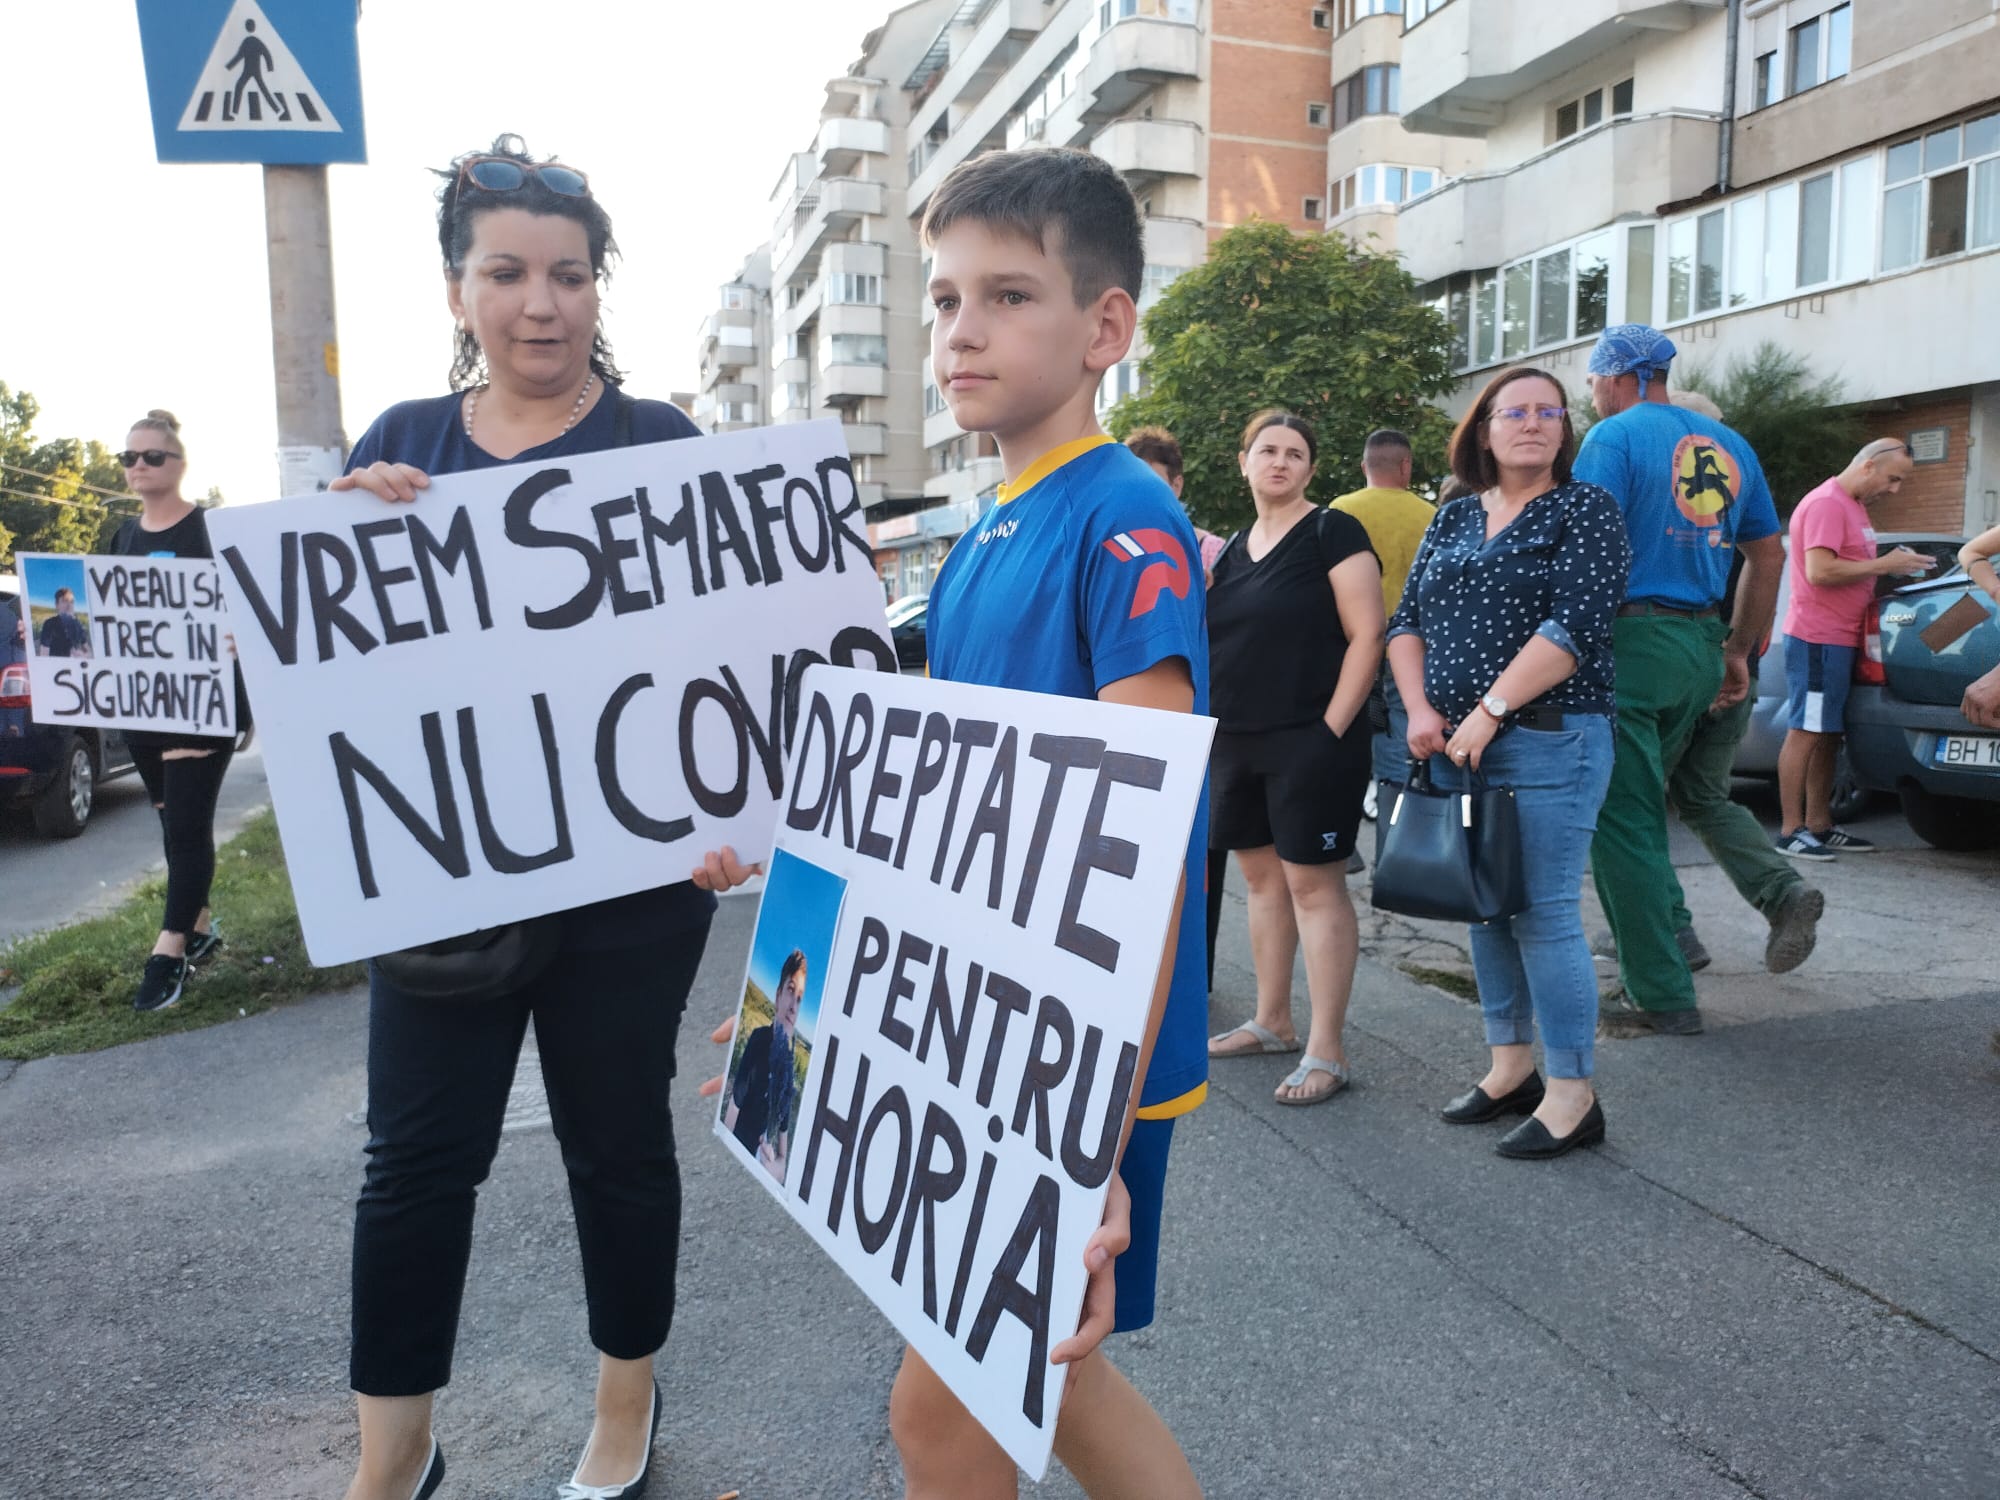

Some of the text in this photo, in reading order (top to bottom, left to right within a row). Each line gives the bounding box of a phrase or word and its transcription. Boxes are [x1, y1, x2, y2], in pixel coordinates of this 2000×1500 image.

[89, 564, 186, 609] VREAU
[95, 611, 218, 662] TREC ÎN
[222, 456, 877, 665] VREM SEMAFOR
[329, 692, 575, 900] NU
[786, 690, 1167, 973] DREPTATE
[1947, 739, 1979, 762] BH
[842, 916, 1139, 1190] PENTRU
